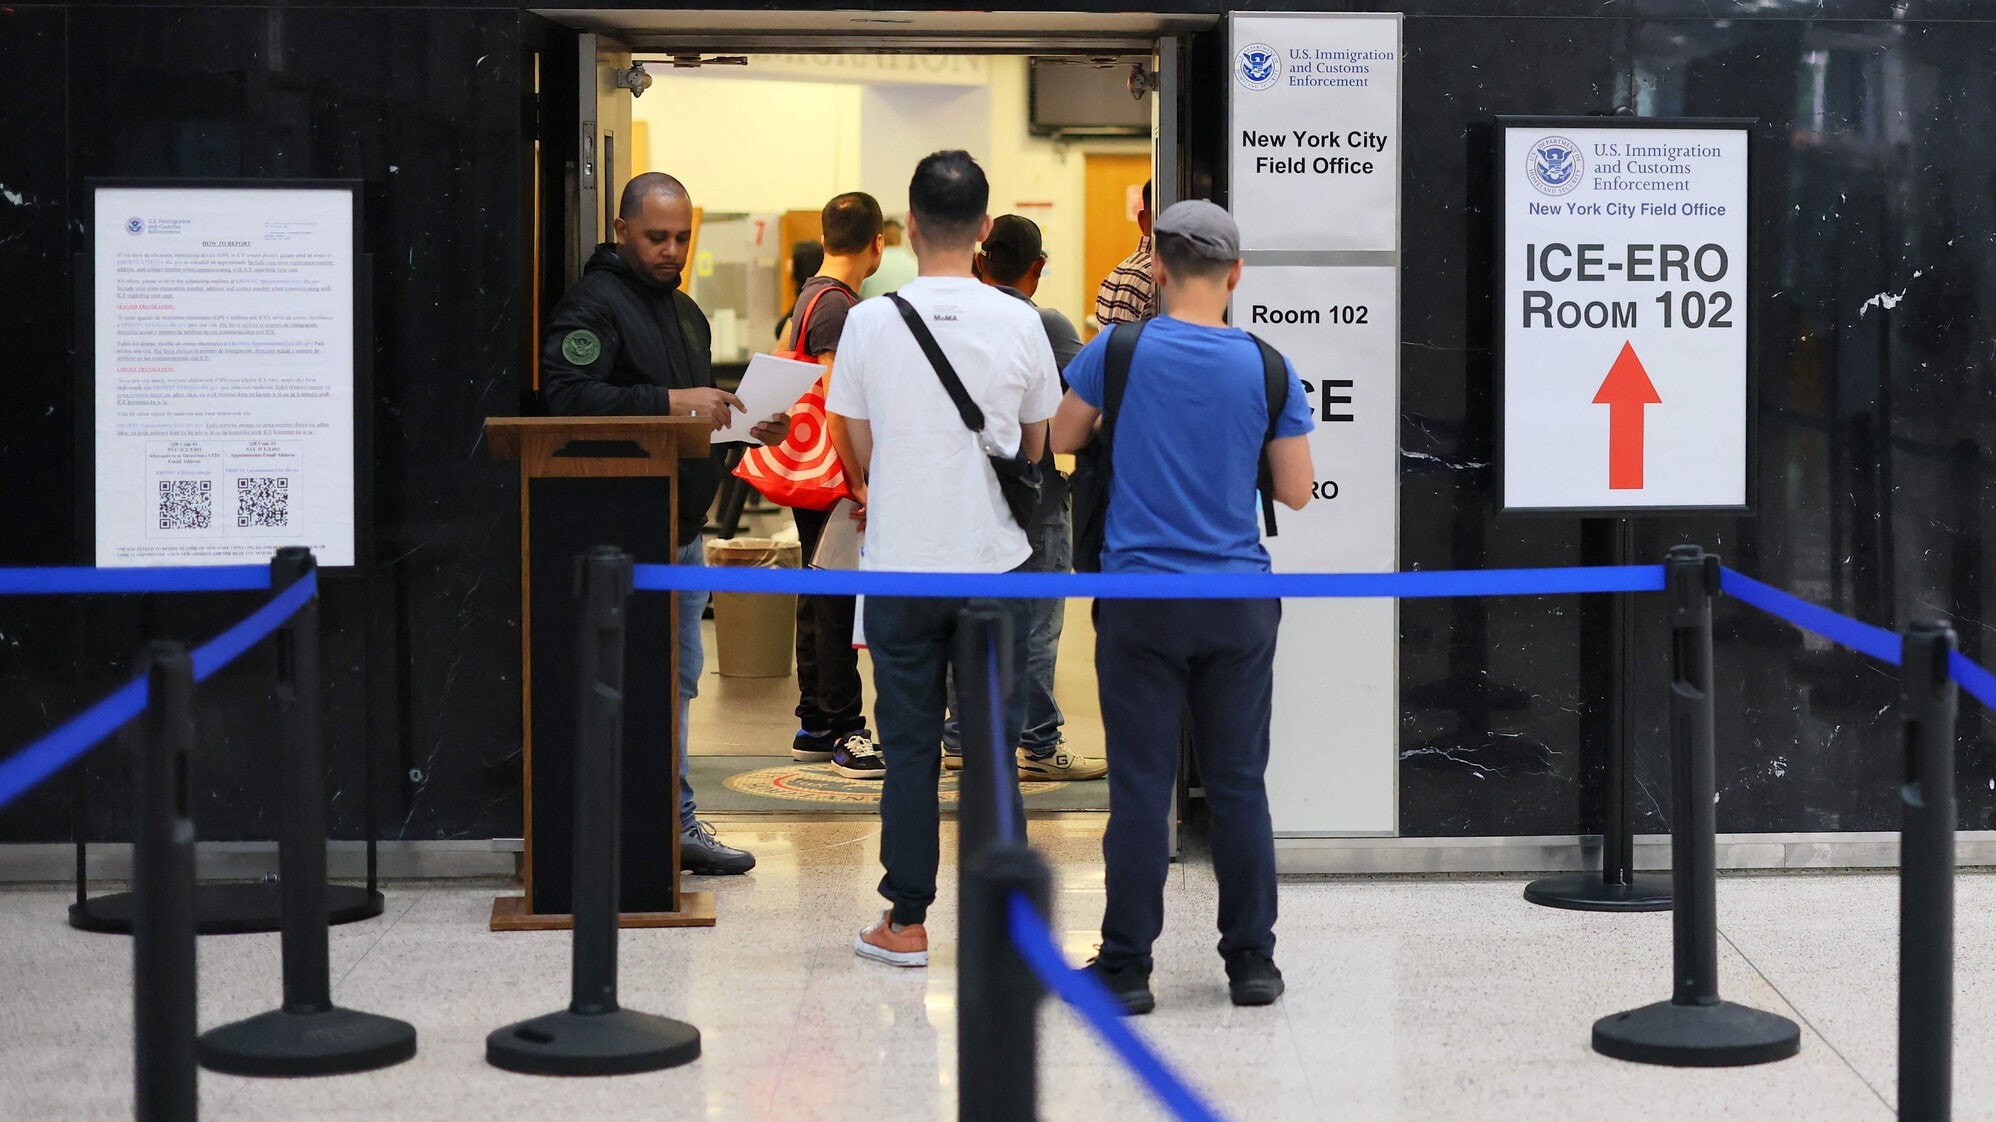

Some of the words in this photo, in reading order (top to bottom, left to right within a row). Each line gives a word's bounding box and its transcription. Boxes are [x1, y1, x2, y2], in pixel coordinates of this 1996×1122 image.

[1289, 49, 1311, 60] U.S.
[1316, 49, 1394, 64] Immigration
[1289, 63, 1312, 74] and
[1316, 63, 1370, 74] Customs
[1288, 76, 1368, 87] Enforcement
[1242, 130, 1286, 148] New
[1292, 130, 1340, 148] York
[1347, 132, 1388, 152] City
[1594, 143, 1620, 156] U.S.
[1625, 143, 1721, 162] Immigration
[1256, 157, 1306, 174] Field
[1312, 157, 1374, 174] Office
[1594, 160, 1620, 174] and
[1627, 160, 1691, 174] Customs
[1594, 176, 1690, 192] Enforcement
[1529, 202, 1561, 216] New
[1566, 202, 1601, 216] York
[1606, 202, 1636, 219] City
[1640, 202, 1677, 216] Field
[1681, 202, 1726, 216] Office
[1526, 243, 1729, 283] ICE-ERO
[1252, 305, 1320, 324] Room
[1329, 305, 1368, 324] 102
[1655, 290, 1733, 329] 102
